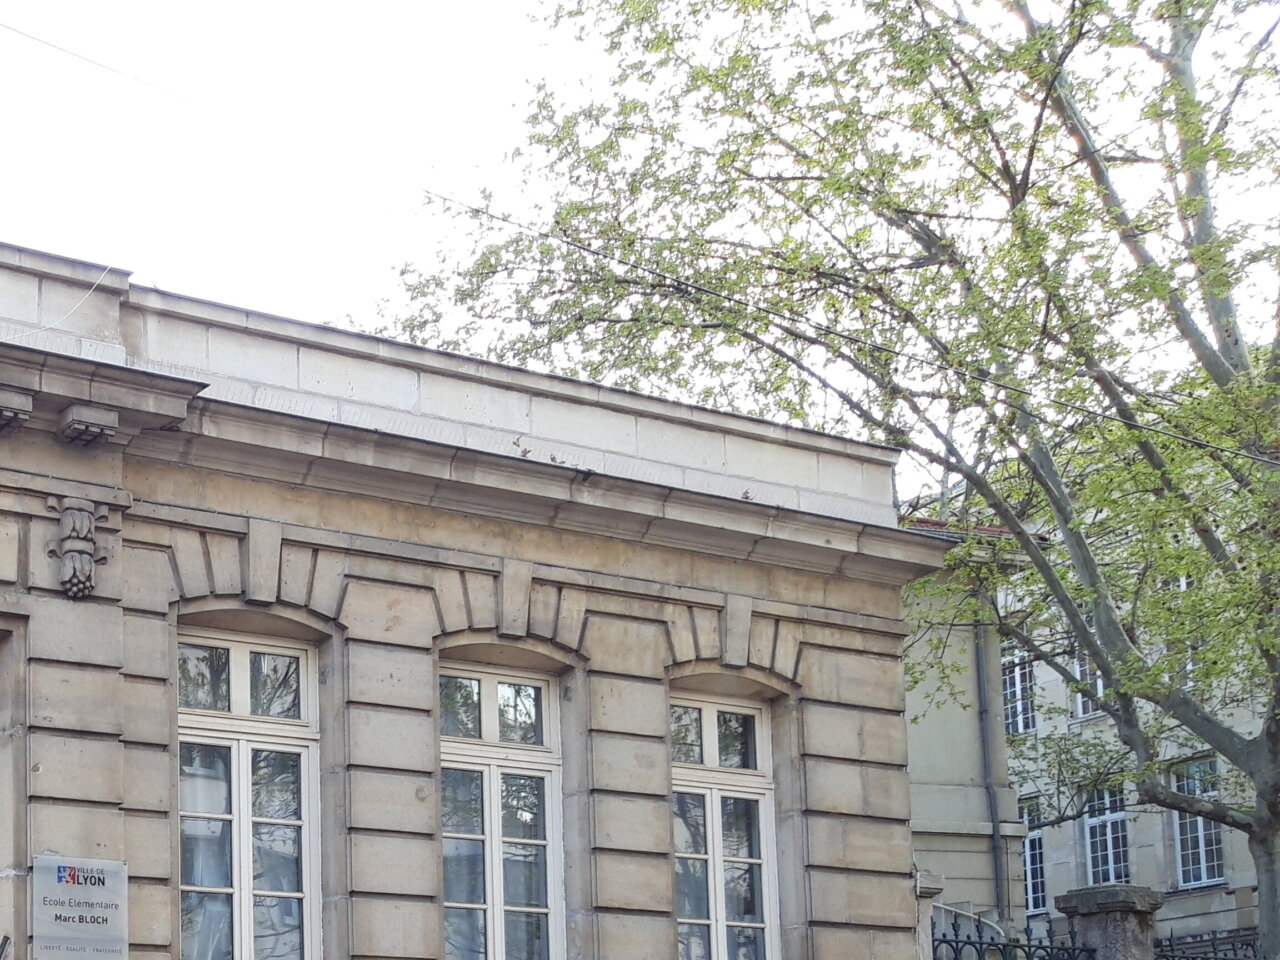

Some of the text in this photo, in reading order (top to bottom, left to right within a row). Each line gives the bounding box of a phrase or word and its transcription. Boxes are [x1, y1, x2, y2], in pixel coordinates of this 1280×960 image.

[77, 866, 94, 875] VILLE
[77, 875, 105, 887] LYON
[55, 913, 108, 925] Marc BLOCH
